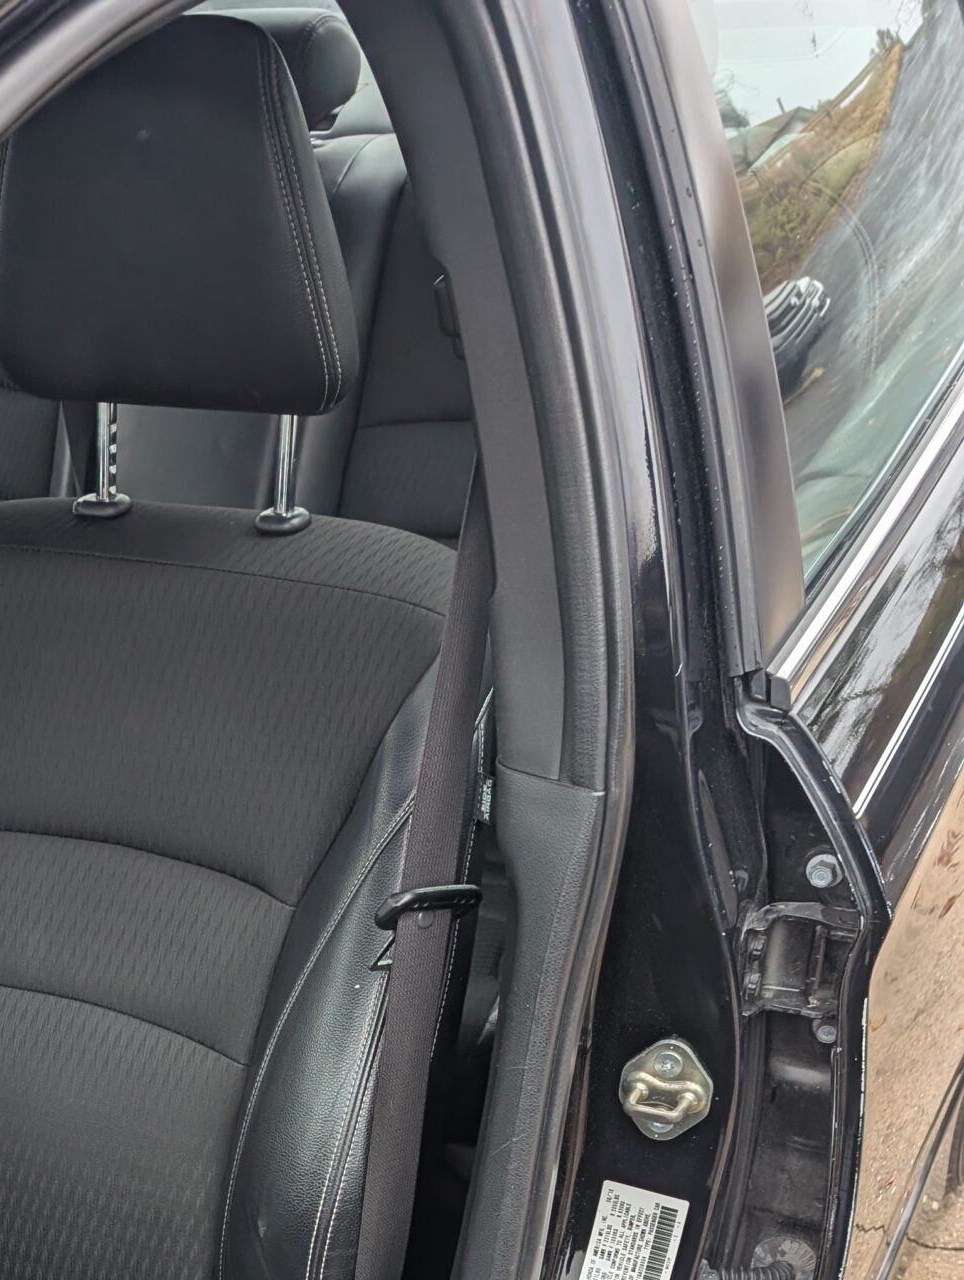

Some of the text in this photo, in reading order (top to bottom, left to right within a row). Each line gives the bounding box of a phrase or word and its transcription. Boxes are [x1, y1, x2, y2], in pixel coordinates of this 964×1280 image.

[483, 779, 492, 821] AIRBAG
[609, 1247, 620, 1269] CONFORMS
[615, 1238, 622, 1246] TO
[620, 1202, 631, 1228] APPLICABLE
[627, 1231, 638, 1255] STANDARDS
[636, 1206, 645, 1223] EFFECT
[646, 1211, 658, 1235] PASSENGER
[585, 1266, 594, 1280] HONDA
[592, 1237, 601, 1257] AMERICA
[616, 1252, 626, 1271] VEHICLE
[630, 1243, 642, 1272] MANUFACTURE
[638, 1227, 647, 1242] SHOWN
